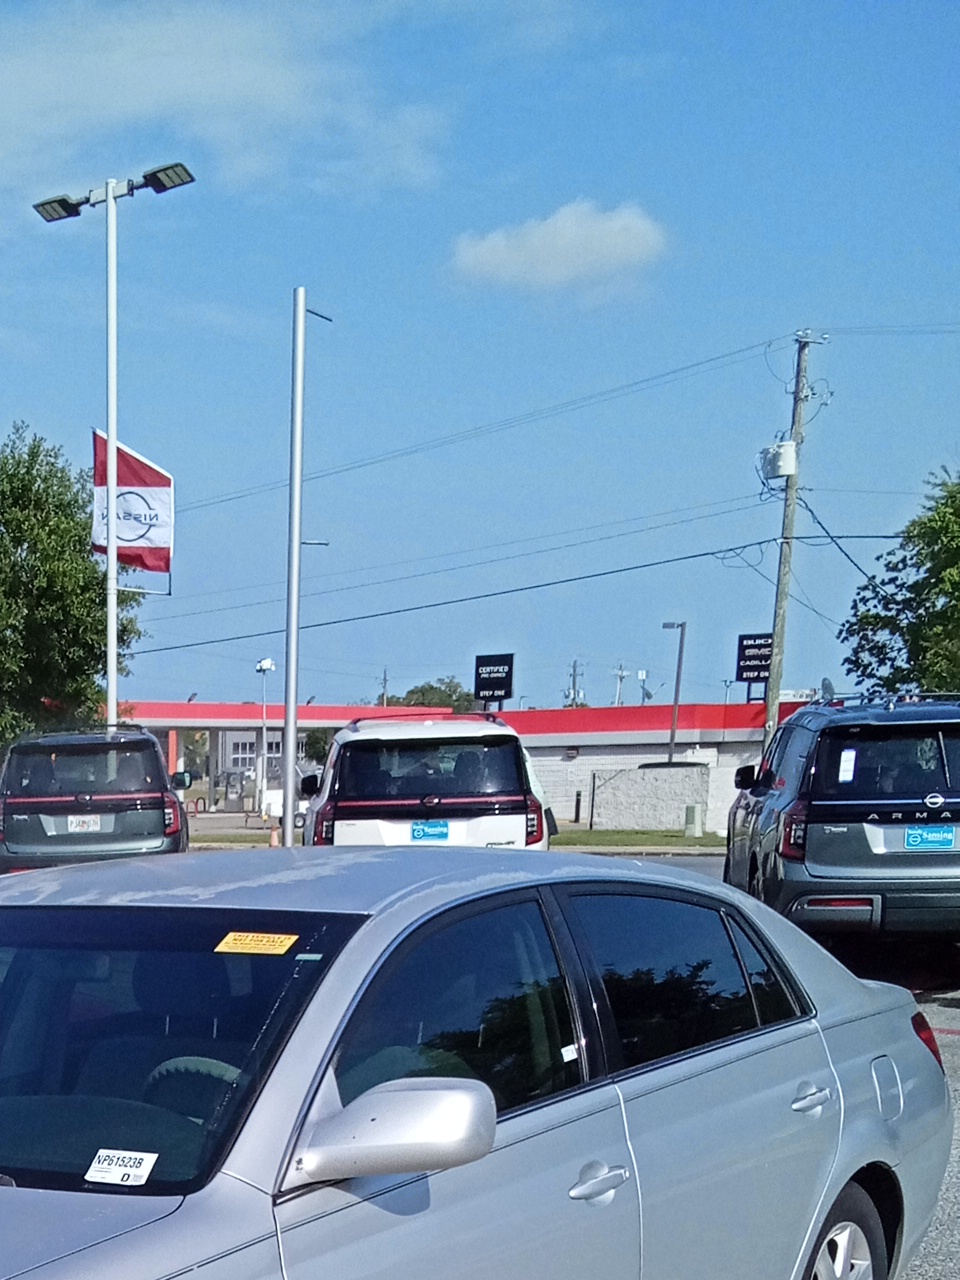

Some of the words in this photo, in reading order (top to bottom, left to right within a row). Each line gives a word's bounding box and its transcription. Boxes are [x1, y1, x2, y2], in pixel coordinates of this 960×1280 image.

[745, 648, 772, 656] GMC
[479, 665, 509, 674] CERTIFIED
[922, 831, 953, 840] Sansing
[94, 1155, 144, 1168] NP61523B
[120, 1173, 131, 1182] D
